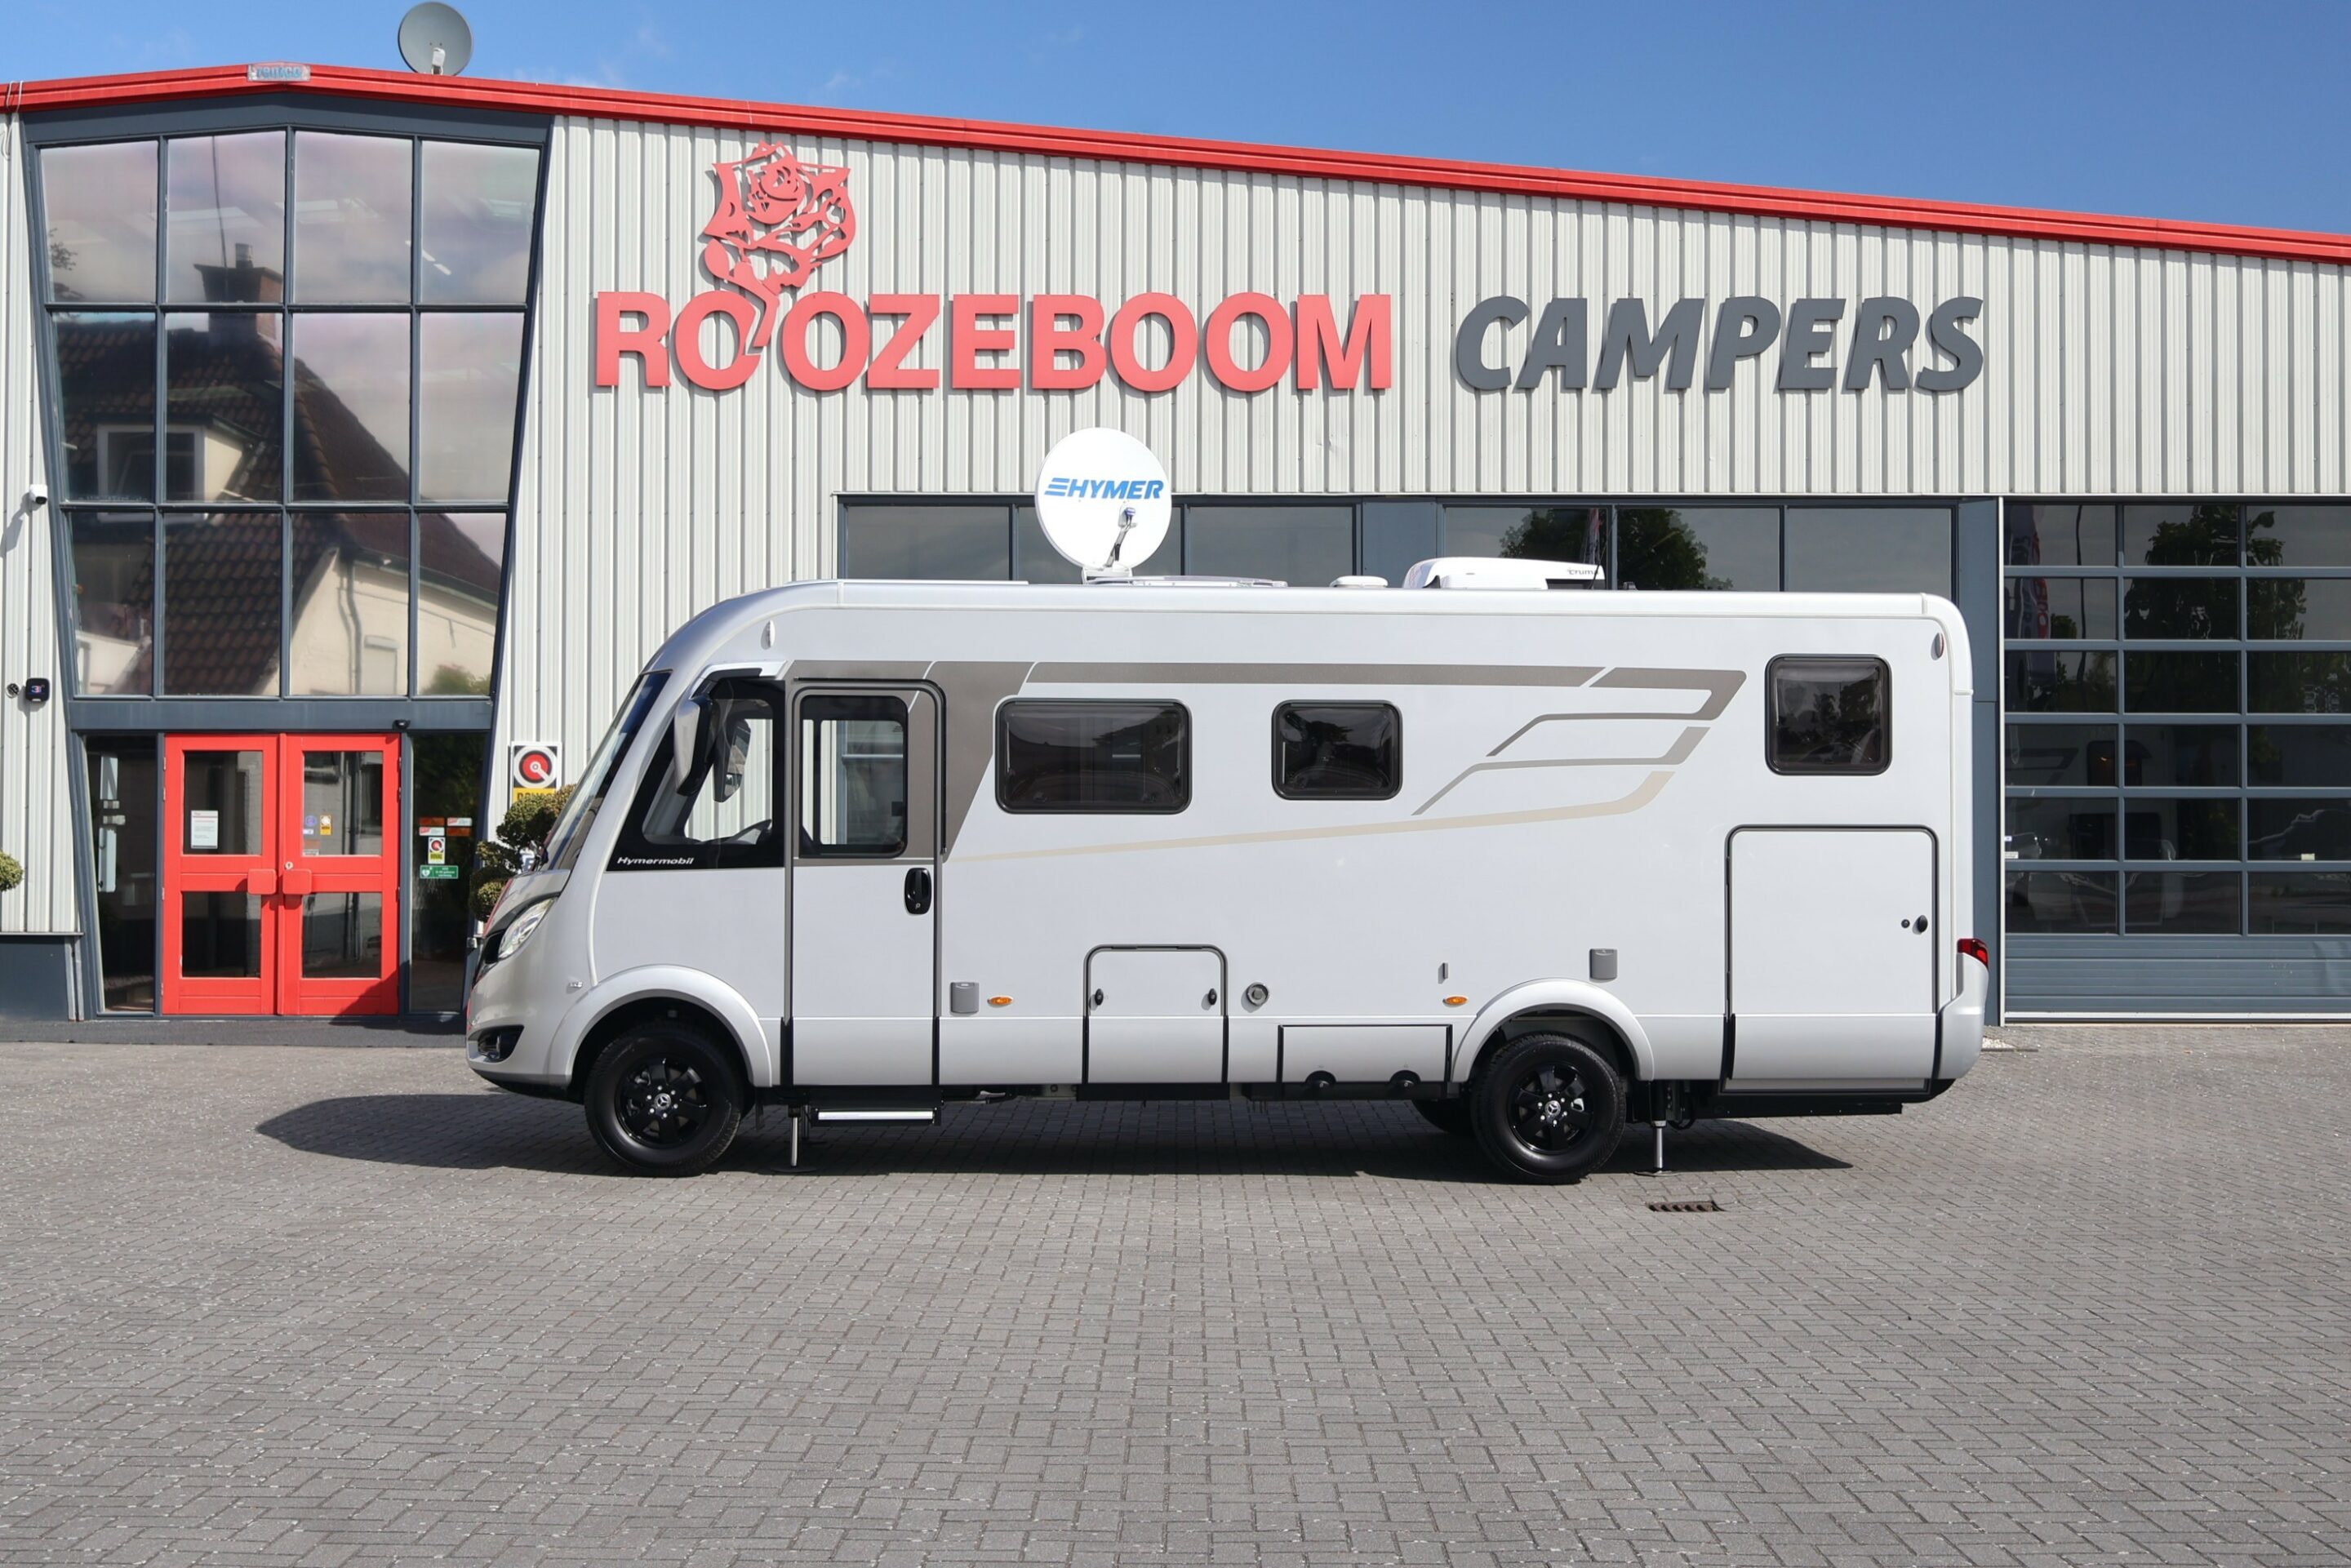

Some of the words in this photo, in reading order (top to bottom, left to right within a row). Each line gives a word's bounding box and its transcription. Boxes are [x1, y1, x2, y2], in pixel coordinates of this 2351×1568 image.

[595, 290, 1392, 392] ROOZEBOOM
[1456, 295, 1984, 393] CAMPERS
[1067, 478, 1164, 500] HYMER
[616, 856, 695, 865] Hymermobil
